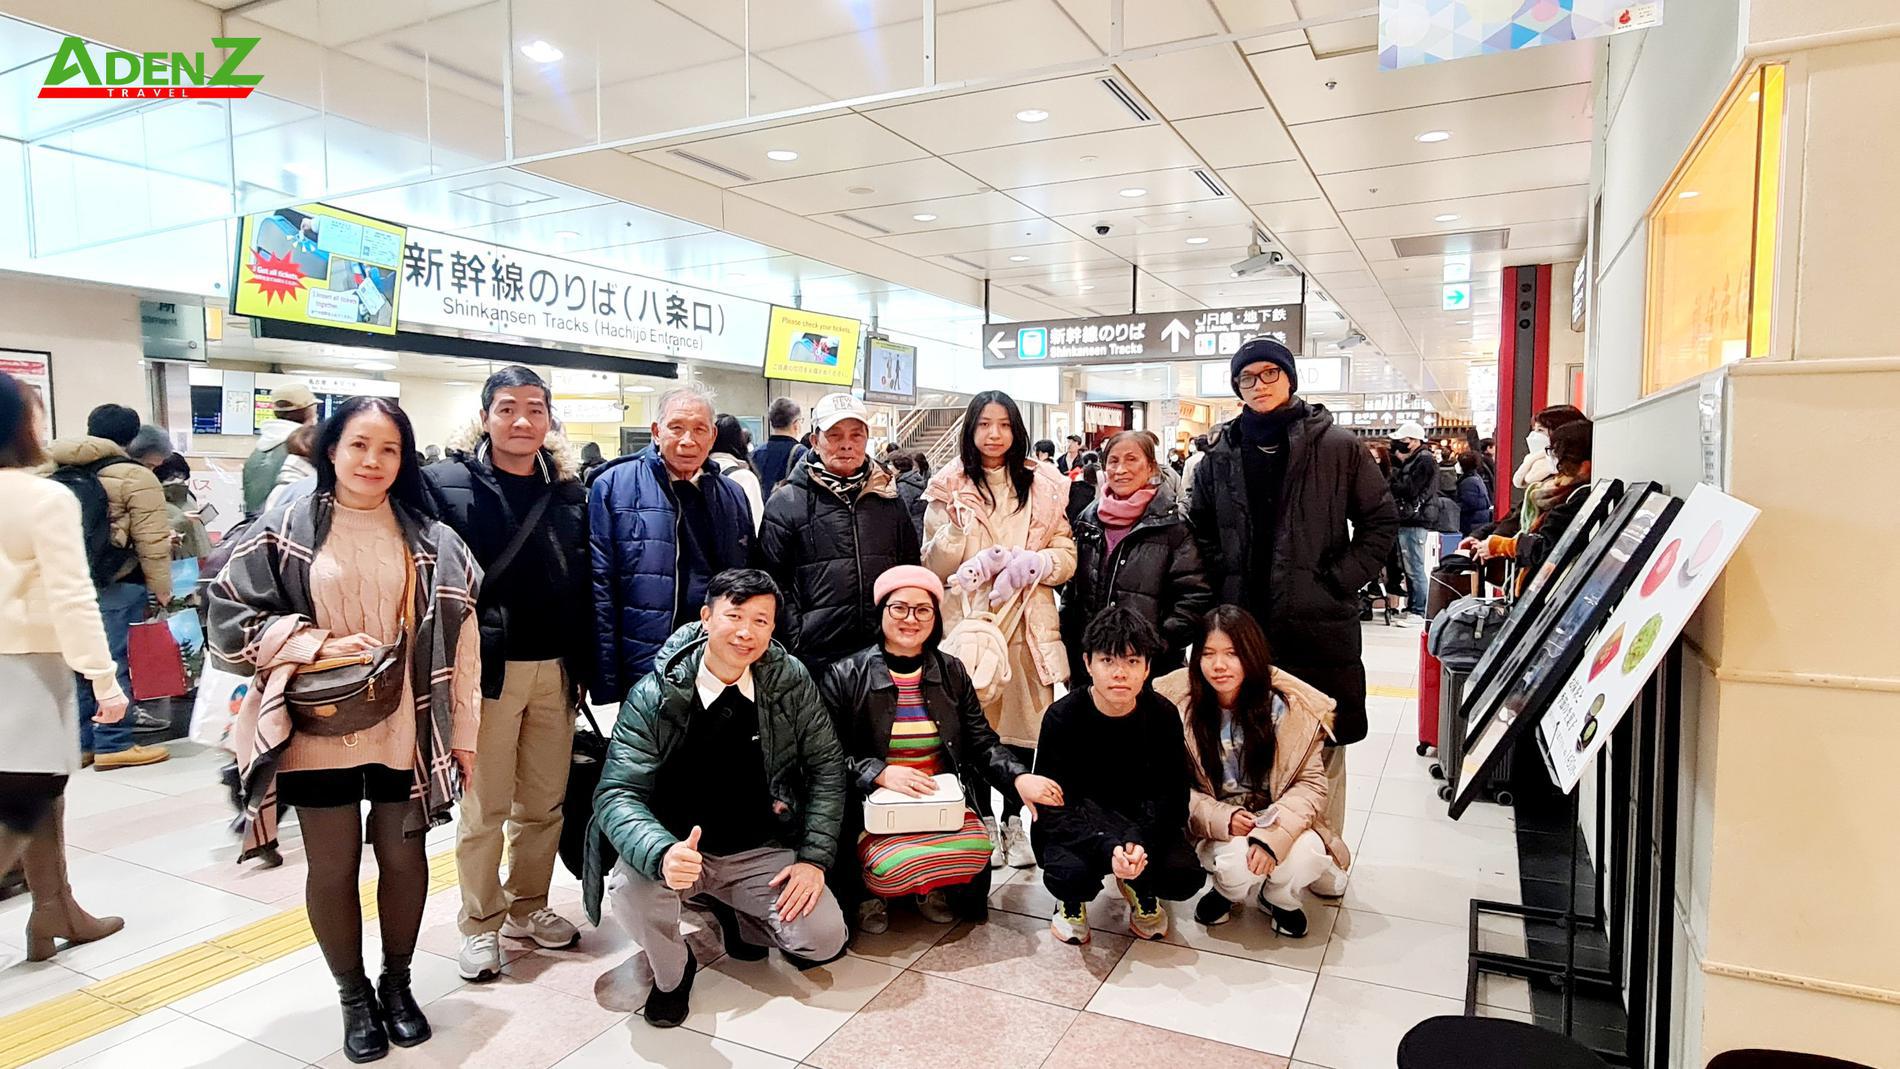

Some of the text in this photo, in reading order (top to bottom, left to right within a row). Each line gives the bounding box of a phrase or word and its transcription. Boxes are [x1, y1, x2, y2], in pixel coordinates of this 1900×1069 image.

[443, 296, 537, 326] Shinkansen
[542, 311, 589, 333] Tracks
[650, 328, 704, 350] Entrance)
[782, 317, 801, 326] Please
[802, 320, 818, 330] check
[1050, 322, 1146, 345] 新幹線のりば
[1050, 342, 1144, 359] Shinkansen Tracks
